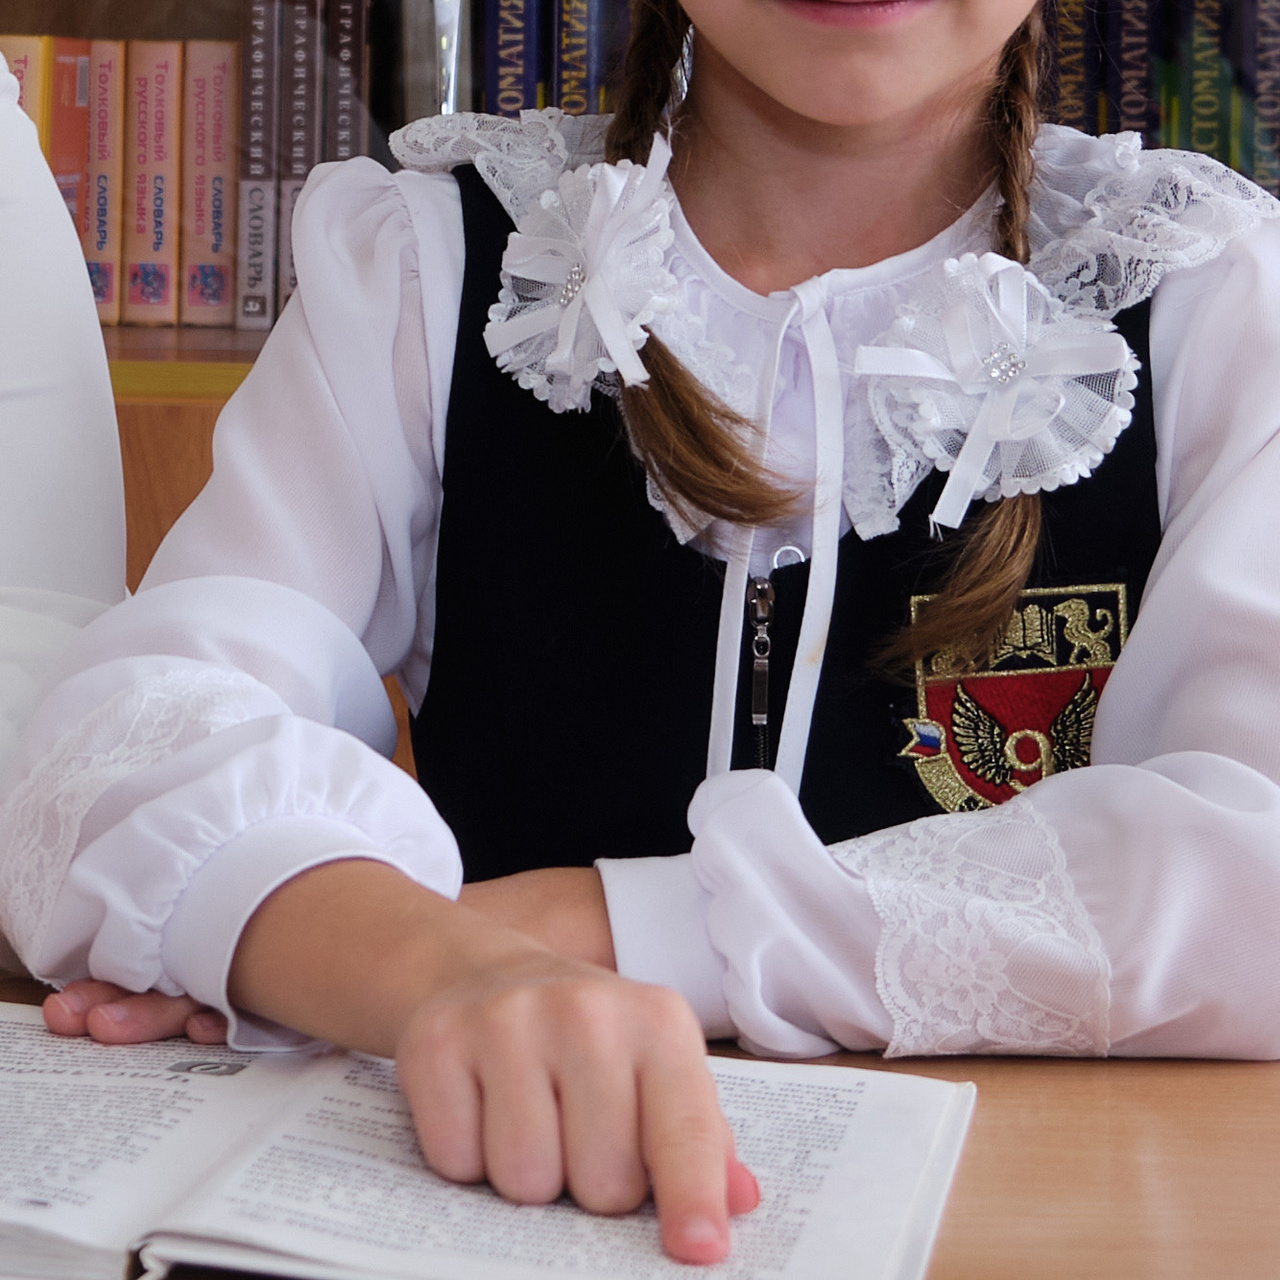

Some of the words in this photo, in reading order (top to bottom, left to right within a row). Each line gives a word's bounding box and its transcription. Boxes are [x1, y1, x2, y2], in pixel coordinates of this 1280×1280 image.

[97, 60, 113, 161] Толковый
[134, 76, 148, 166] русского
[153, 60, 169, 162] Толковый
[192, 77, 206, 167] русского
[212, 61, 227, 163] Толковый
[135, 173, 148, 235] языка
[194, 174, 207, 236] языка
[246, 186, 265, 289] СЛОВАРЬ
[1005, 729, 1056, 792] 9
